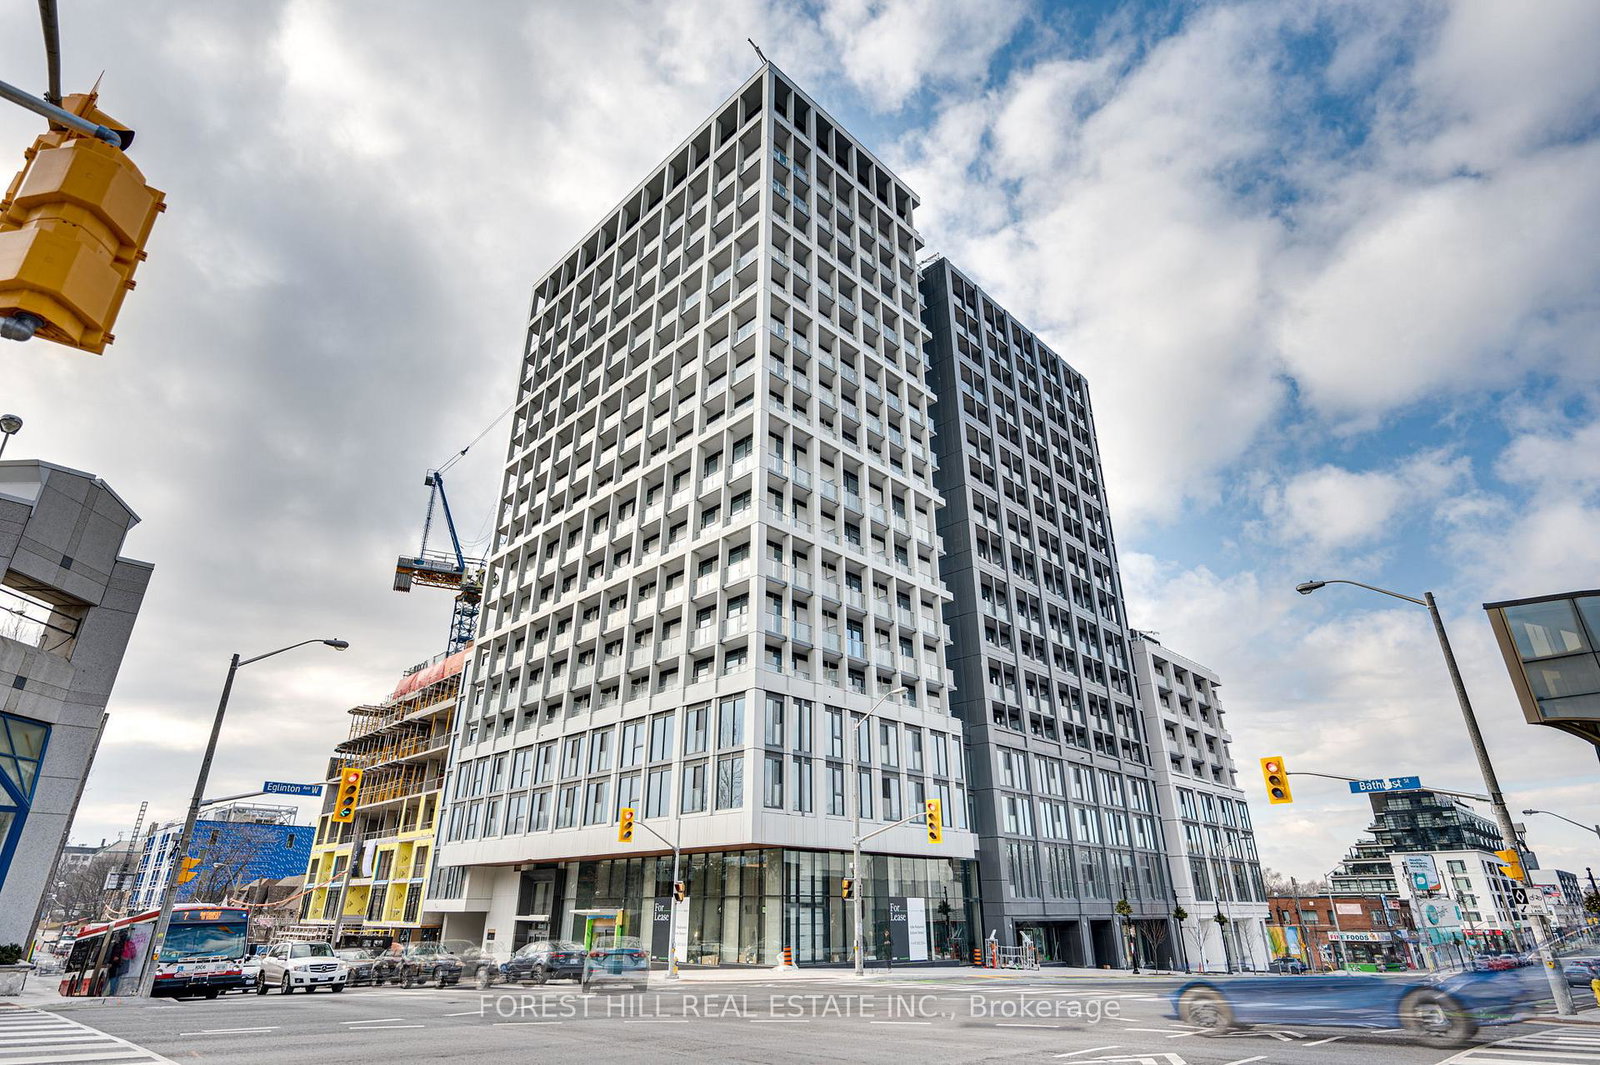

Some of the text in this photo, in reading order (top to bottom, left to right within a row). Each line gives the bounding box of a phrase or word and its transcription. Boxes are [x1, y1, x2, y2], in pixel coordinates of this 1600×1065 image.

[267, 782, 301, 793] Eglinton
[311, 786, 320, 794] W
[1359, 779, 1402, 790] Bathst
[655, 902, 664, 912] For
[890, 902, 900, 912] For
[655, 911, 670, 921] Lease
[890, 911, 906, 921] Lease
